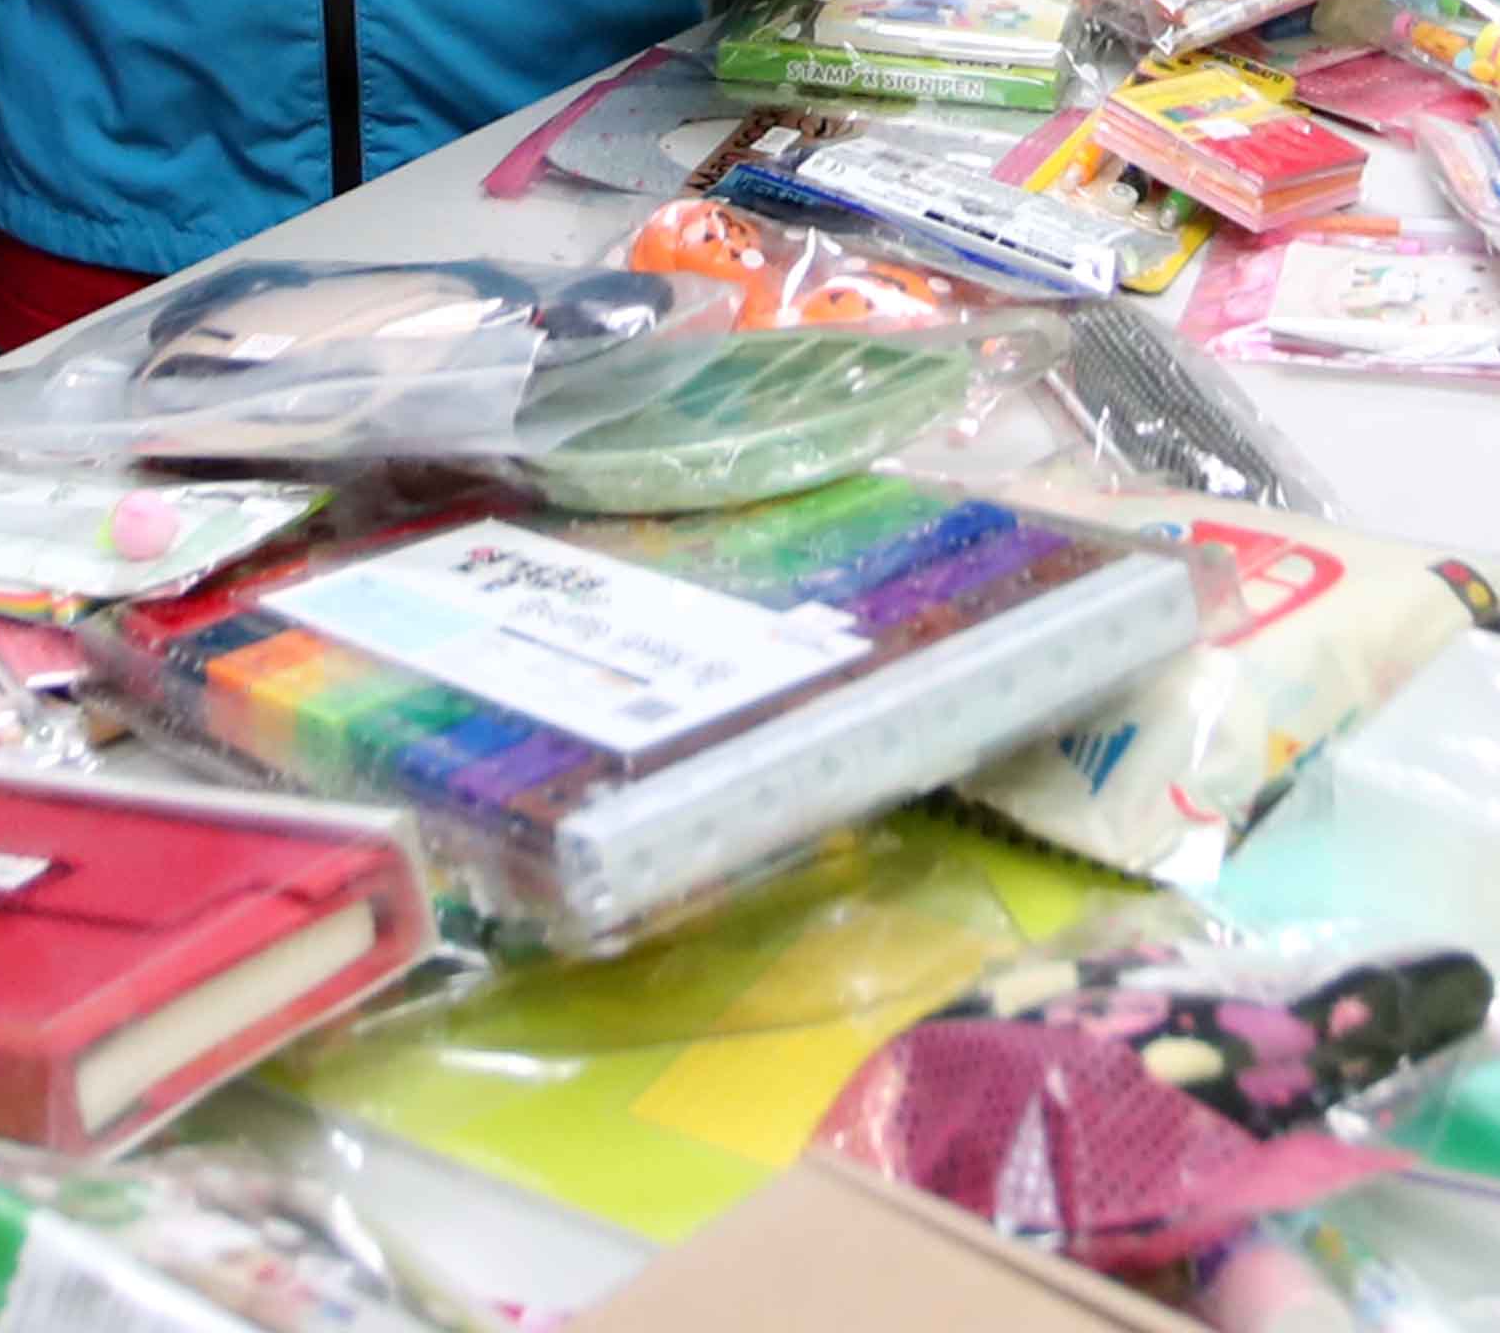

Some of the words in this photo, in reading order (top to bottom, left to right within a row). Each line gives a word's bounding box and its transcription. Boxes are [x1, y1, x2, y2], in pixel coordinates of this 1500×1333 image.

[785, 60, 859, 85] STAMP
[882, 70, 933, 95] SIGN
[934, 78, 986, 102] PEN
